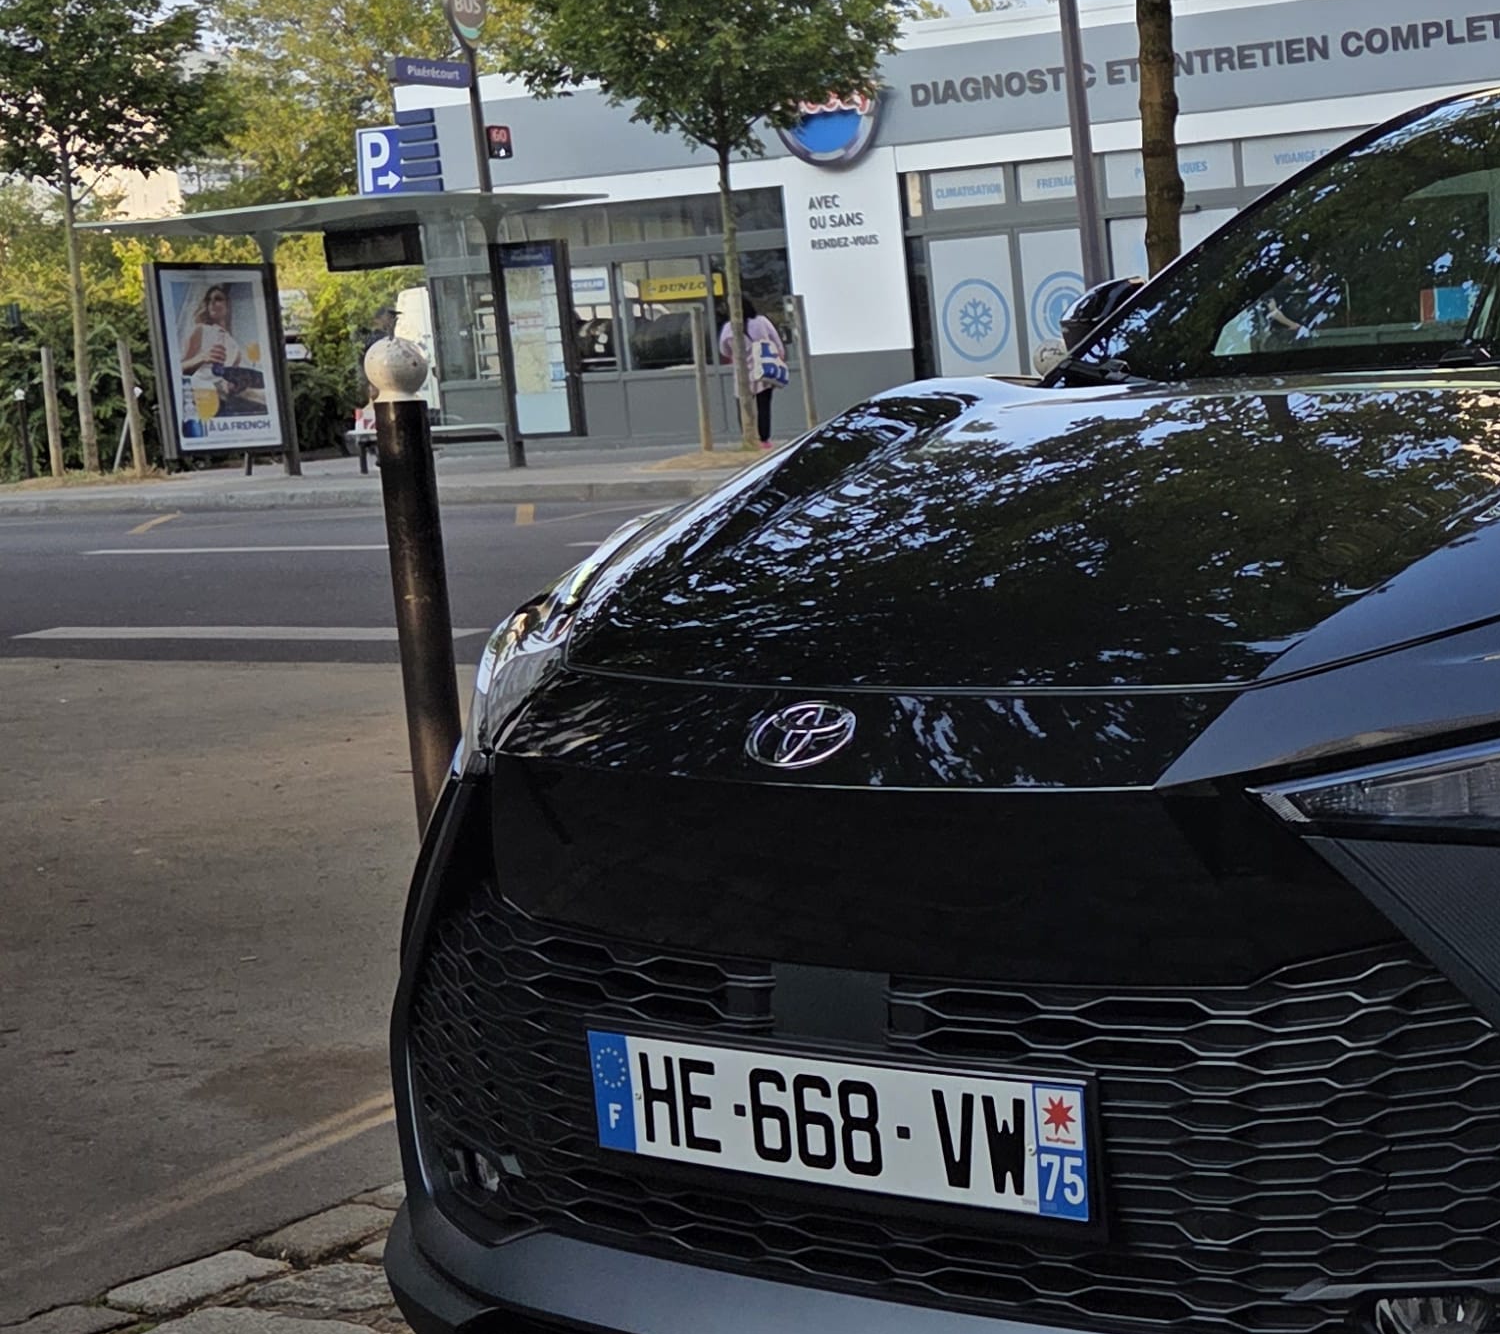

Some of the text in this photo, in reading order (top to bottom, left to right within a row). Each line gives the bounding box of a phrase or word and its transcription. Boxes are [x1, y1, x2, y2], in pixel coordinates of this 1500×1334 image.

[910, 63, 1097, 107] DIAGNOSTC
[1105, 58, 1141, 85] ET
[1173, 35, 1330, 77] NTRETIEN
[361, 132, 390, 193] P
[1273, 150, 1316, 165] VIDANGE
[935, 182, 1001, 199] CLIMATISATION
[808, 195, 840, 210] AVEC
[809, 212, 864, 229] OU SANS
[811, 234, 880, 250] RENDEZ-VOUS
[658, 281, 717, 293] DUNLO
[219, 421, 230, 431] LA
[231, 419, 271, 430] FRENCH
[608, 1102, 622, 1130] F
[1040, 1153, 1085, 1205] 75
